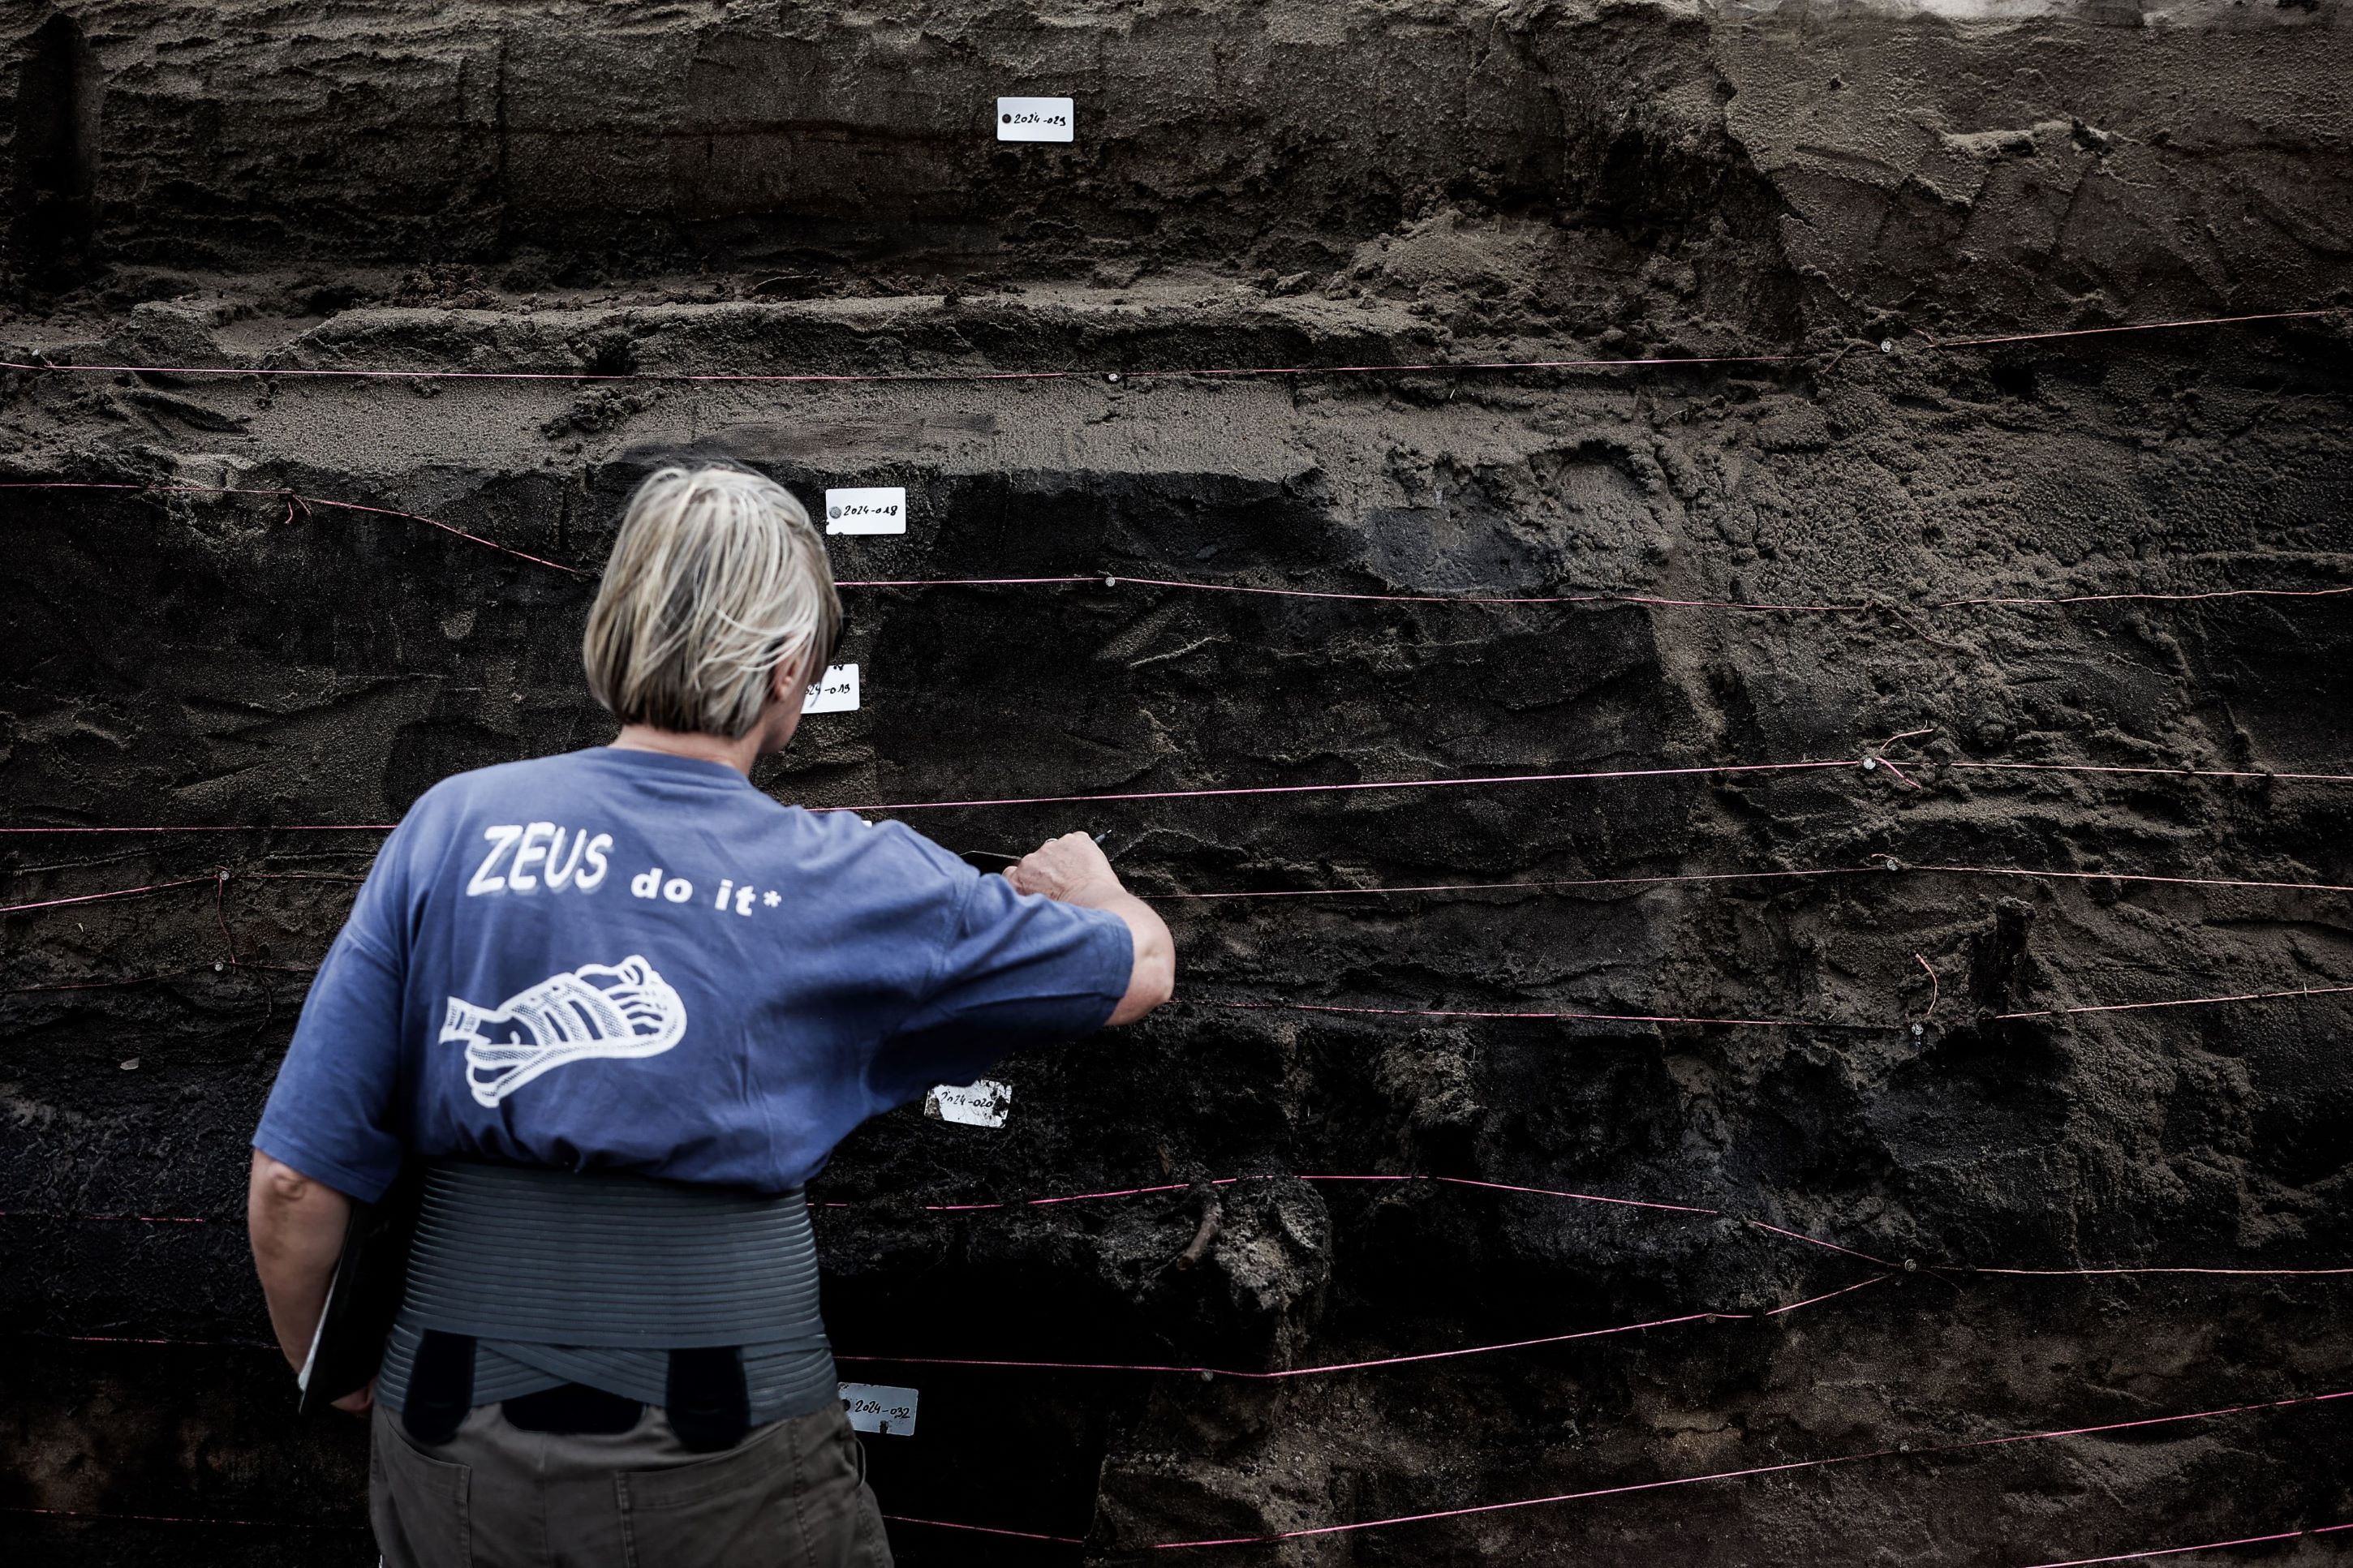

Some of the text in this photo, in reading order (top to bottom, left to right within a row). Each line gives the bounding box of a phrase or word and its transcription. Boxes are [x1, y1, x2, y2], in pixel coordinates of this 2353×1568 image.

[843, 505, 898, 517] 2024-018
[466, 823, 614, 896] ZEUS
[630, 868, 693, 903] do
[855, 1400, 910, 1419] 2024-032
